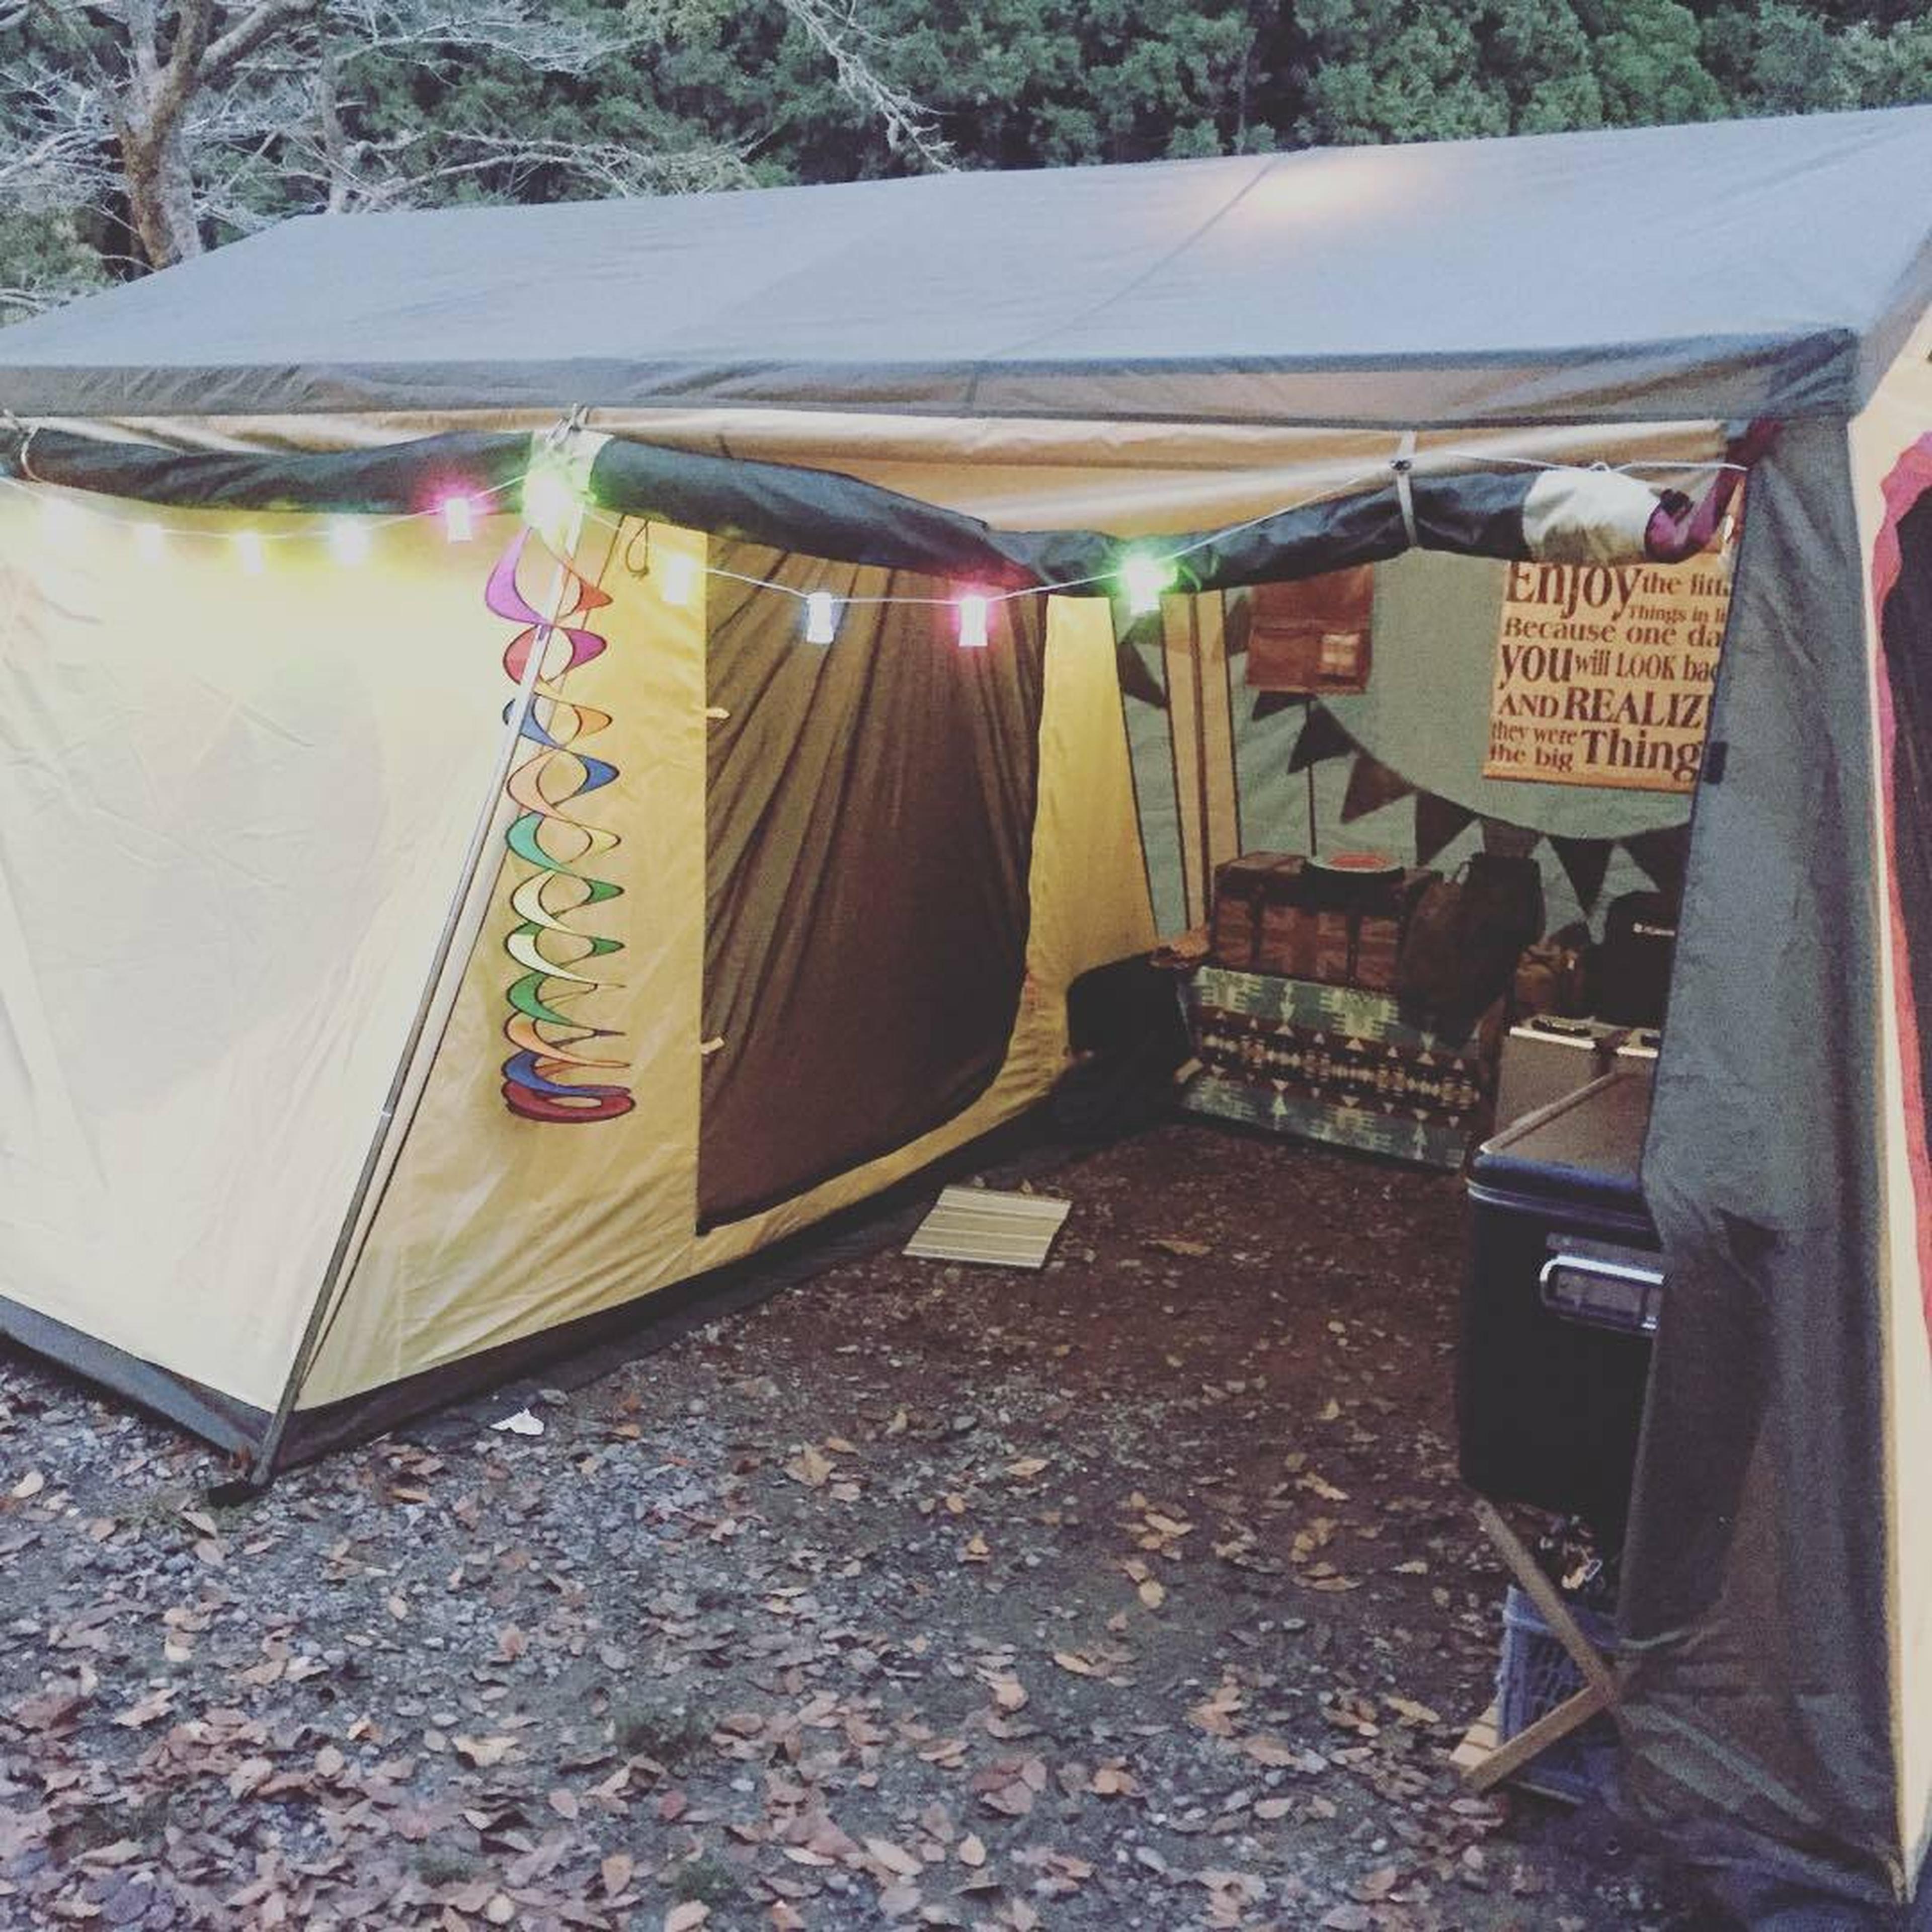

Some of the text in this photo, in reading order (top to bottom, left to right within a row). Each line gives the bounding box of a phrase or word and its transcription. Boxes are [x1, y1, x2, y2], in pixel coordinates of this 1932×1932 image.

[1506, 561, 1642, 621] Enjoy
[1642, 572, 1681, 595] the
[1504, 617, 1721, 647] Because one da
[1628, 604, 1686, 624] Things
[1692, 606, 1709, 622] in
[1498, 644, 1573, 690] you
[1575, 649, 1611, 676] will
[1615, 652, 1675, 680] LOOK
[1498, 686, 1704, 728] AND REALIZ
[1492, 720, 1577, 745] they were
[1490, 728, 1704, 782] the big Thing
